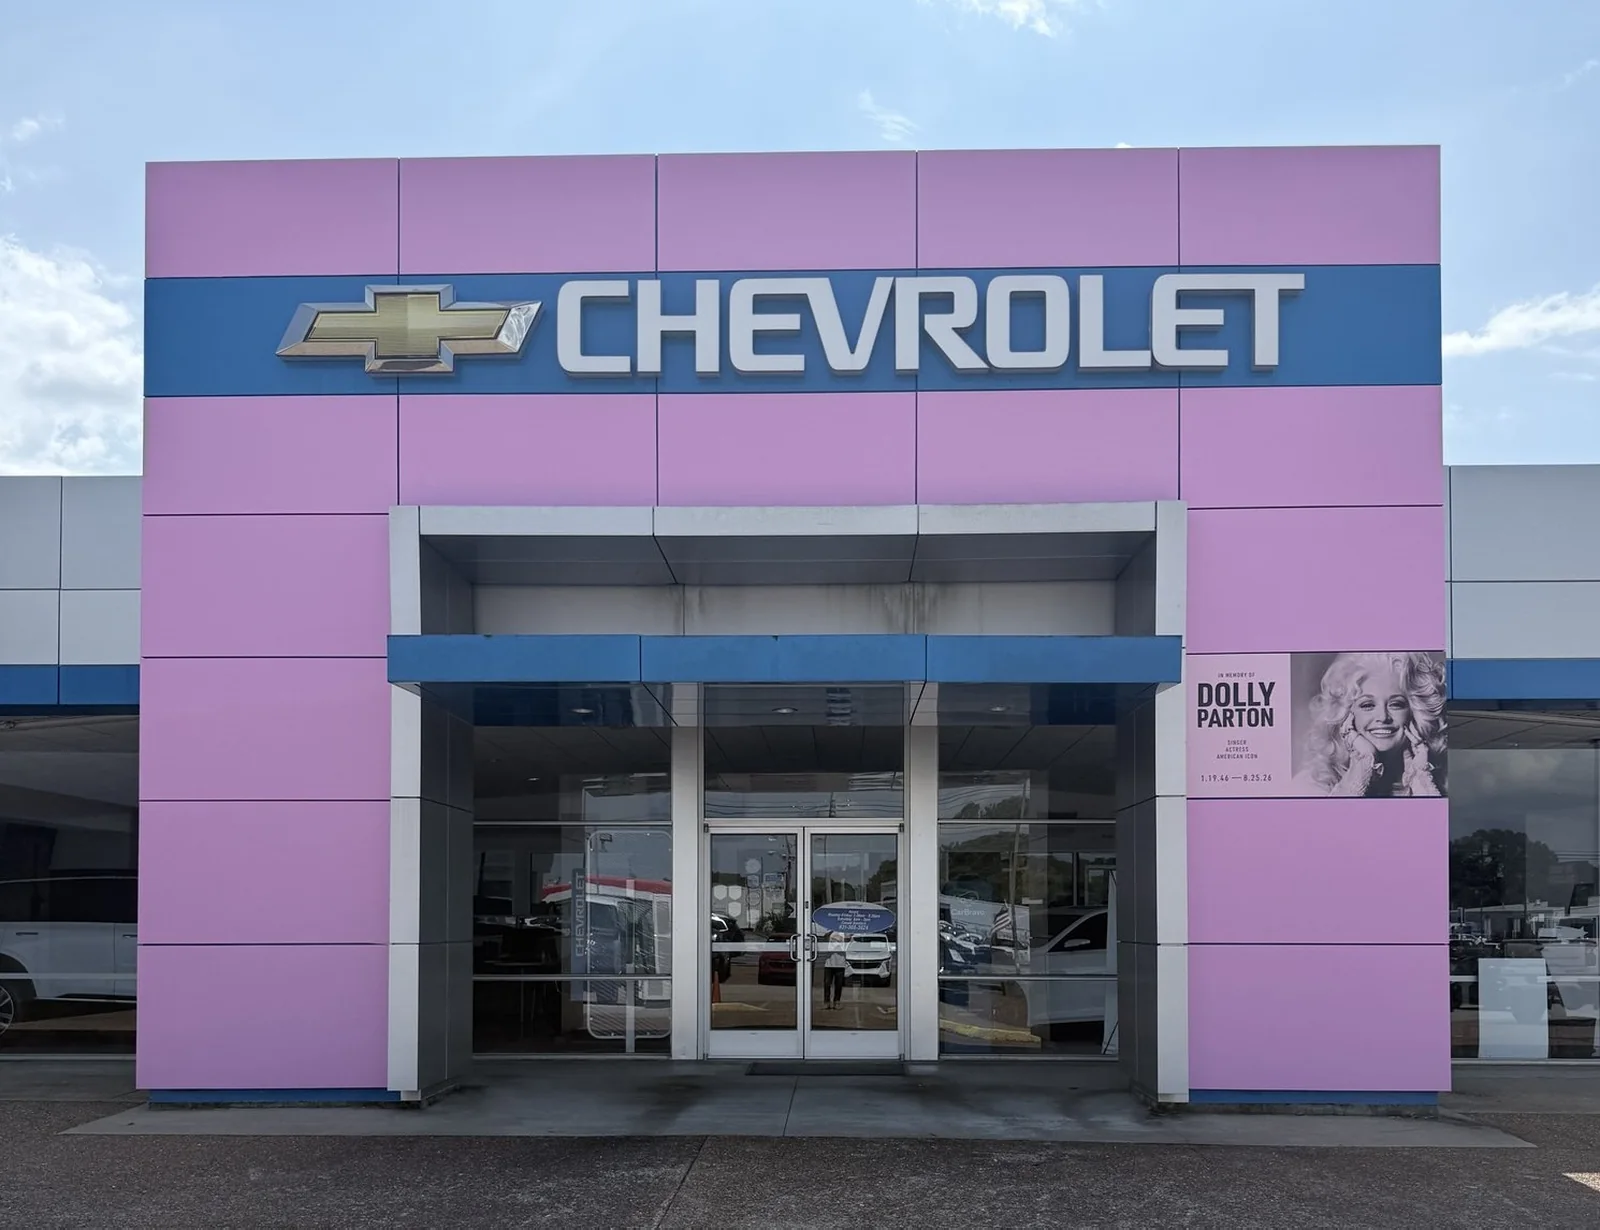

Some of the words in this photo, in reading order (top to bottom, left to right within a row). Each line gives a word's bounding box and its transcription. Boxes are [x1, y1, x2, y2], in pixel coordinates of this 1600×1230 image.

[557, 273, 1305, 374] CHEVROLET
[1198, 682, 1275, 707] DOLLY
[1197, 708, 1274, 728] PARTON
[1201, 774, 1229, 782] 1.19.46
[1243, 774, 1272, 782] 8.25.26
[575, 872, 585, 957] CHEVROLET
